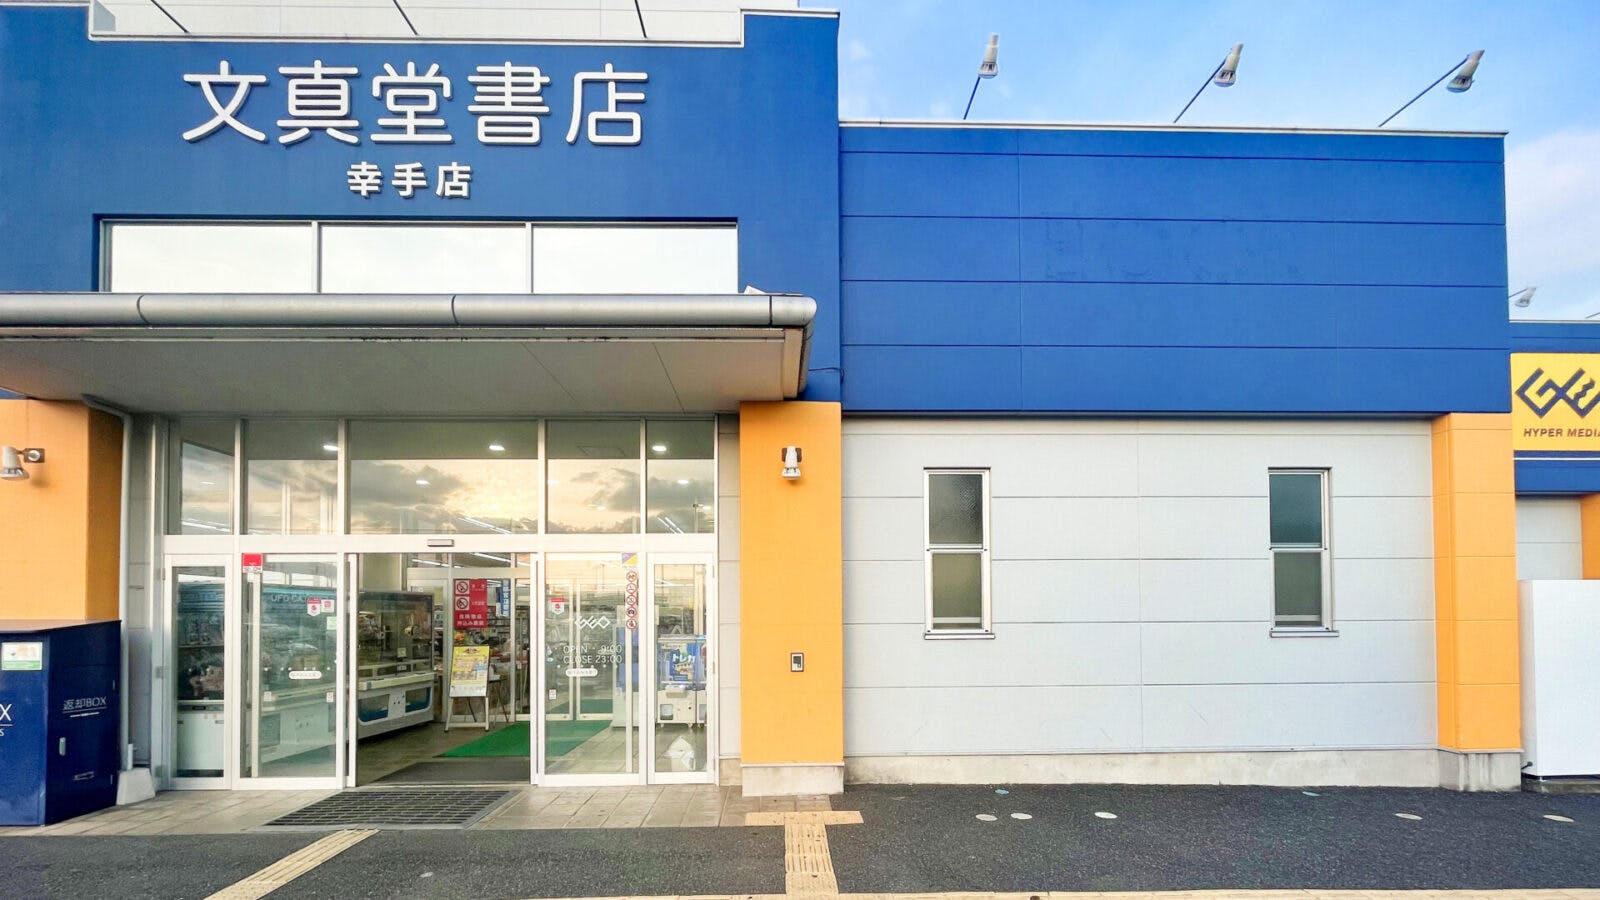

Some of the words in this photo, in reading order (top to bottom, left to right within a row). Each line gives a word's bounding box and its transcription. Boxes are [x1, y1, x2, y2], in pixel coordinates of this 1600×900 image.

[183, 59, 649, 146] 文真堂書店
[346, 161, 472, 198] 幸手店
[1523, 427, 1564, 438] HYPER
[575, 615, 611, 629] GEO
[563, 655, 593, 664] CLOSE
[595, 655, 623, 664] 23:00
[62, 696, 107, 710] 返却BOX
